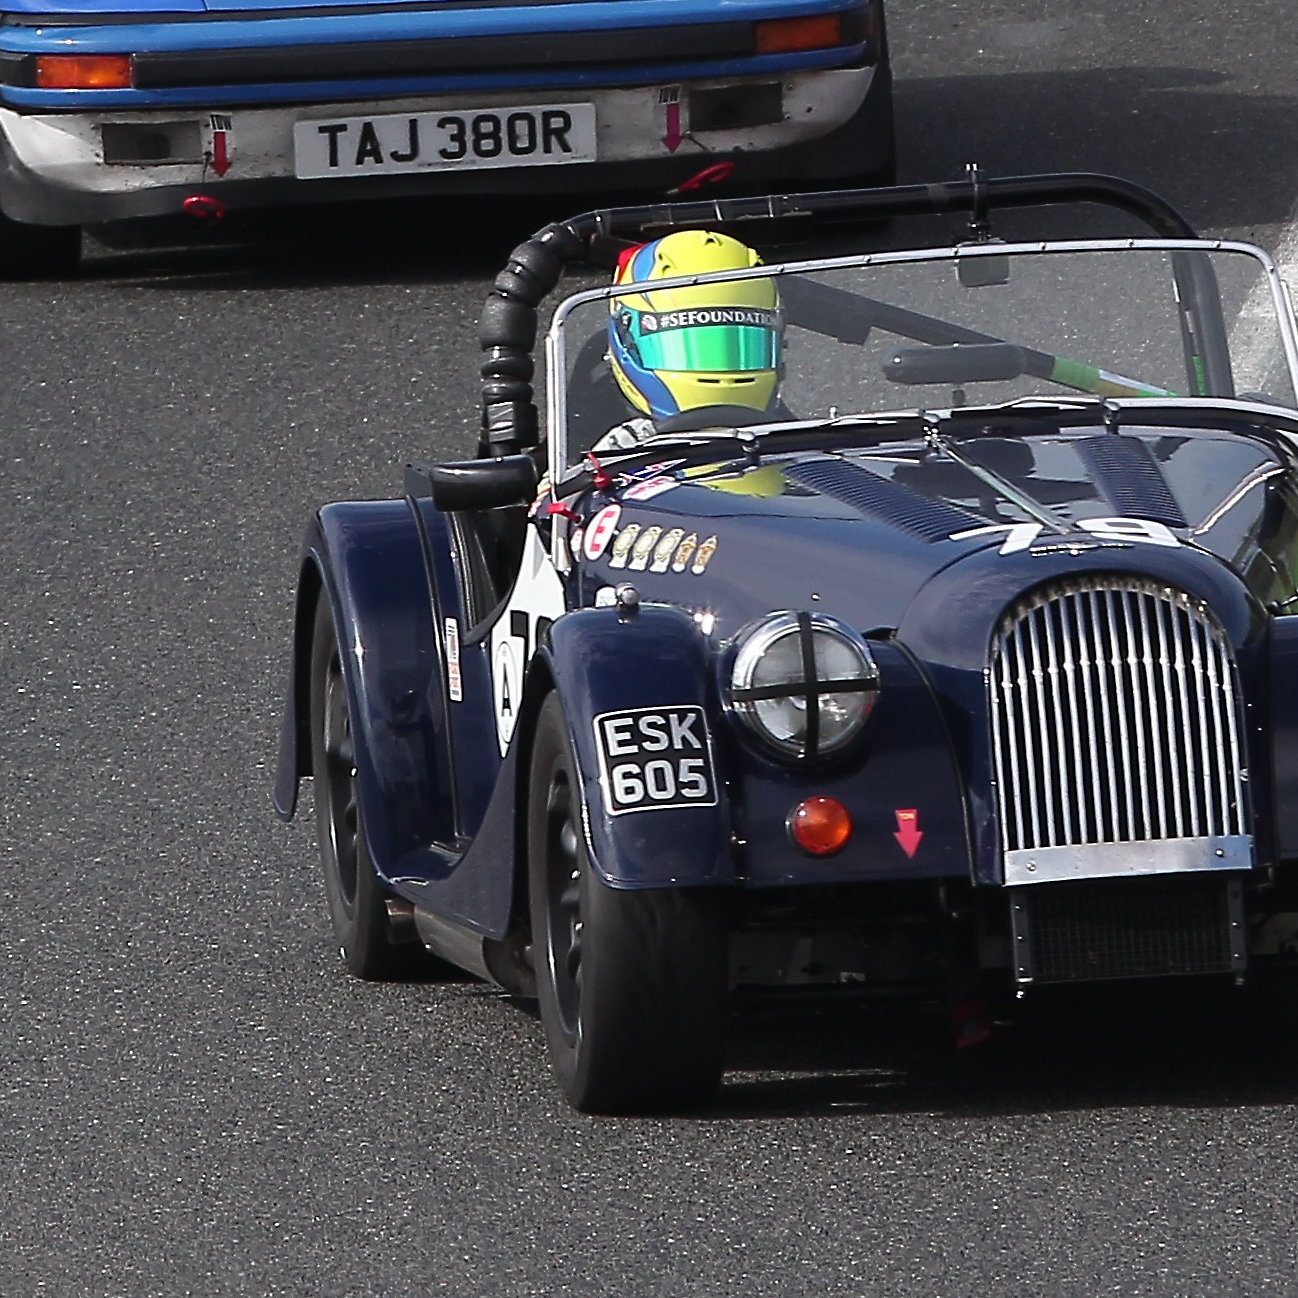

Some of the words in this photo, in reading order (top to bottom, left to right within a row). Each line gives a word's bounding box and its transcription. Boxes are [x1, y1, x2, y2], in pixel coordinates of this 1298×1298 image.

[318, 118, 420, 168] TAJ
[436, 109, 573, 161] 380R
[949, 516, 1183, 557] 79
[604, 713, 702, 757] ESK
[612, 759, 708, 804] 605
